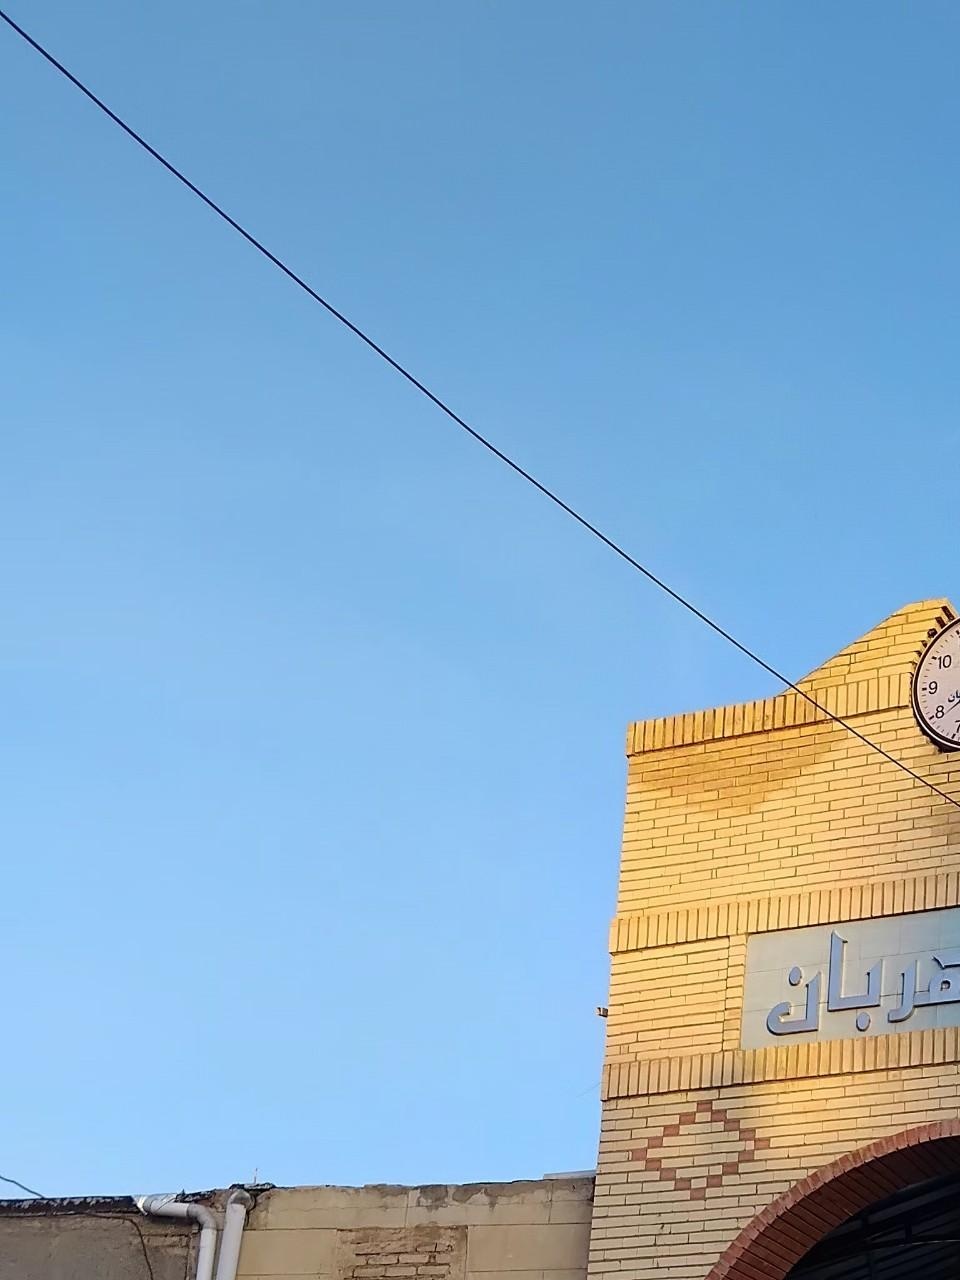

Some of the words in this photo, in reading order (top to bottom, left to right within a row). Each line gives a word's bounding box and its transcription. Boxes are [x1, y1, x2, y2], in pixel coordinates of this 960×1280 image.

[937, 654, 952, 669] 10
[928, 680, 938, 695] 9
[935, 705, 945, 719] 8
